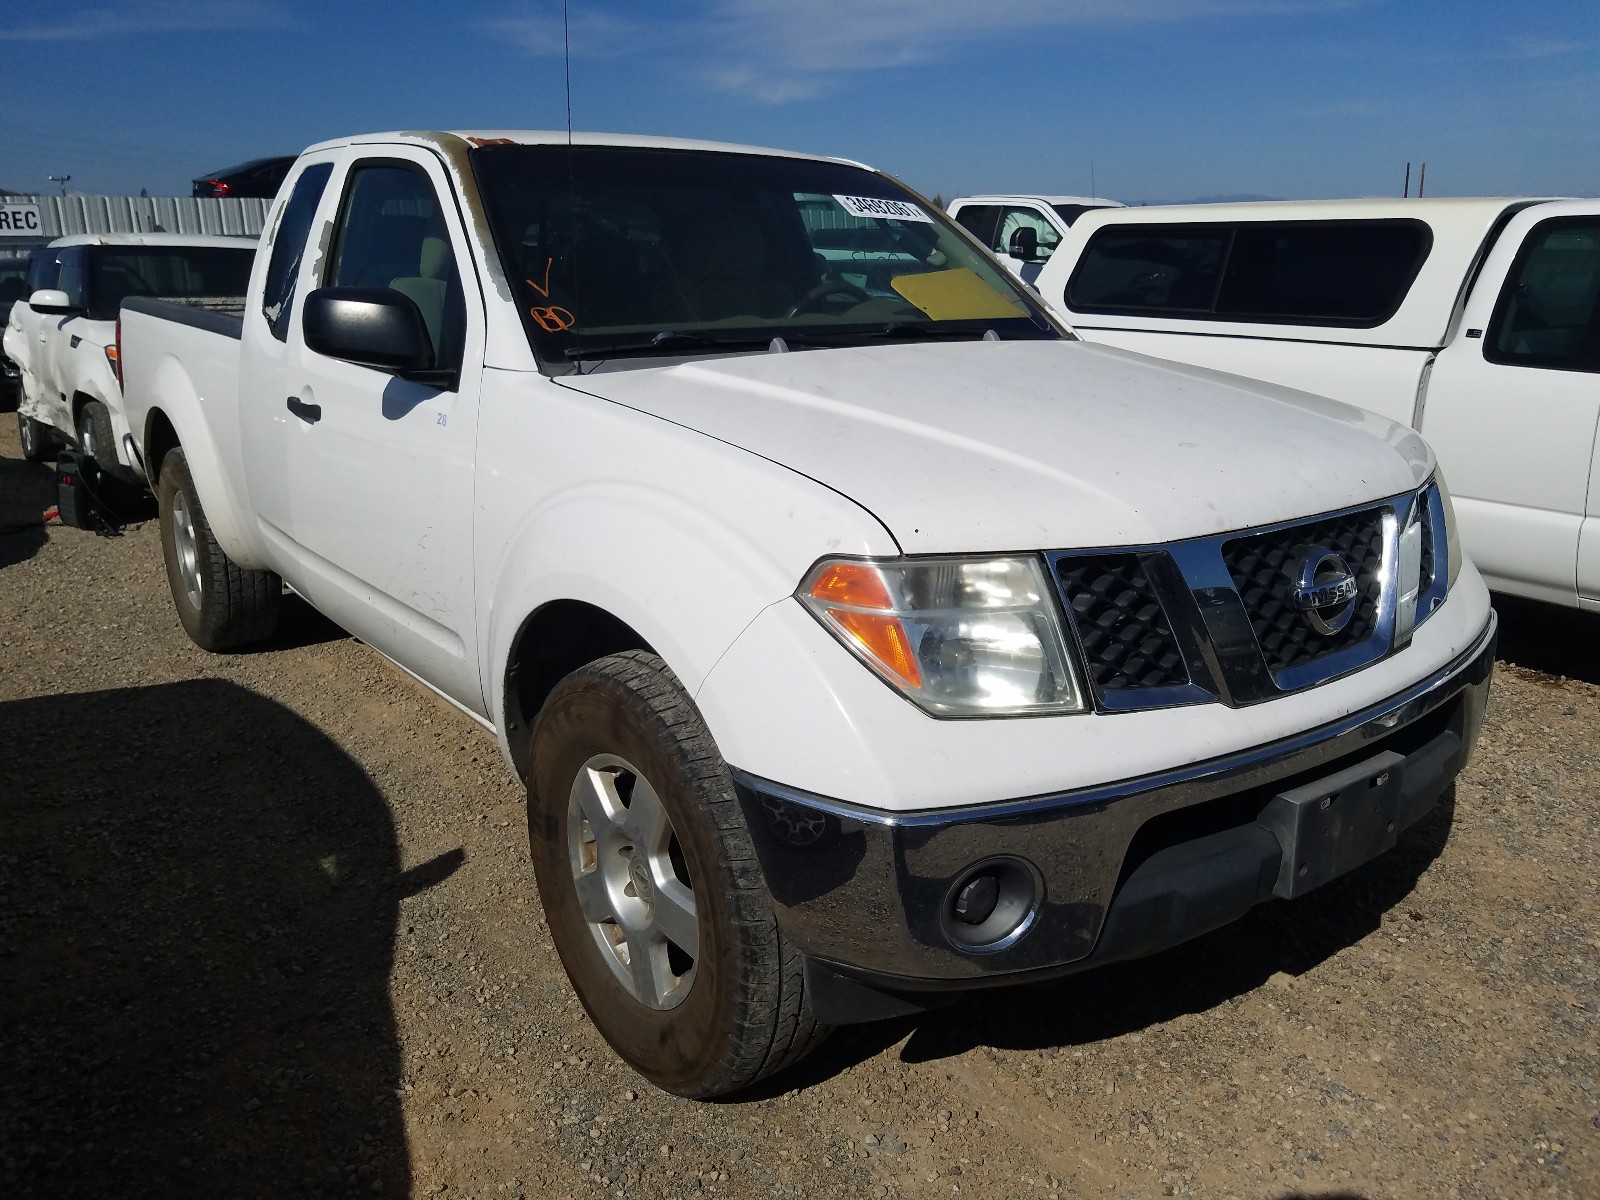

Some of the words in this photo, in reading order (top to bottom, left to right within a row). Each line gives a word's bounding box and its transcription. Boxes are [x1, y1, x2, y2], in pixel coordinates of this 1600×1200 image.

[845, 197, 918, 217] 34692061
[0, 211, 38, 229] REC
[437, 412, 447, 427] 28
[1312, 580, 1357, 606] NISSAN
